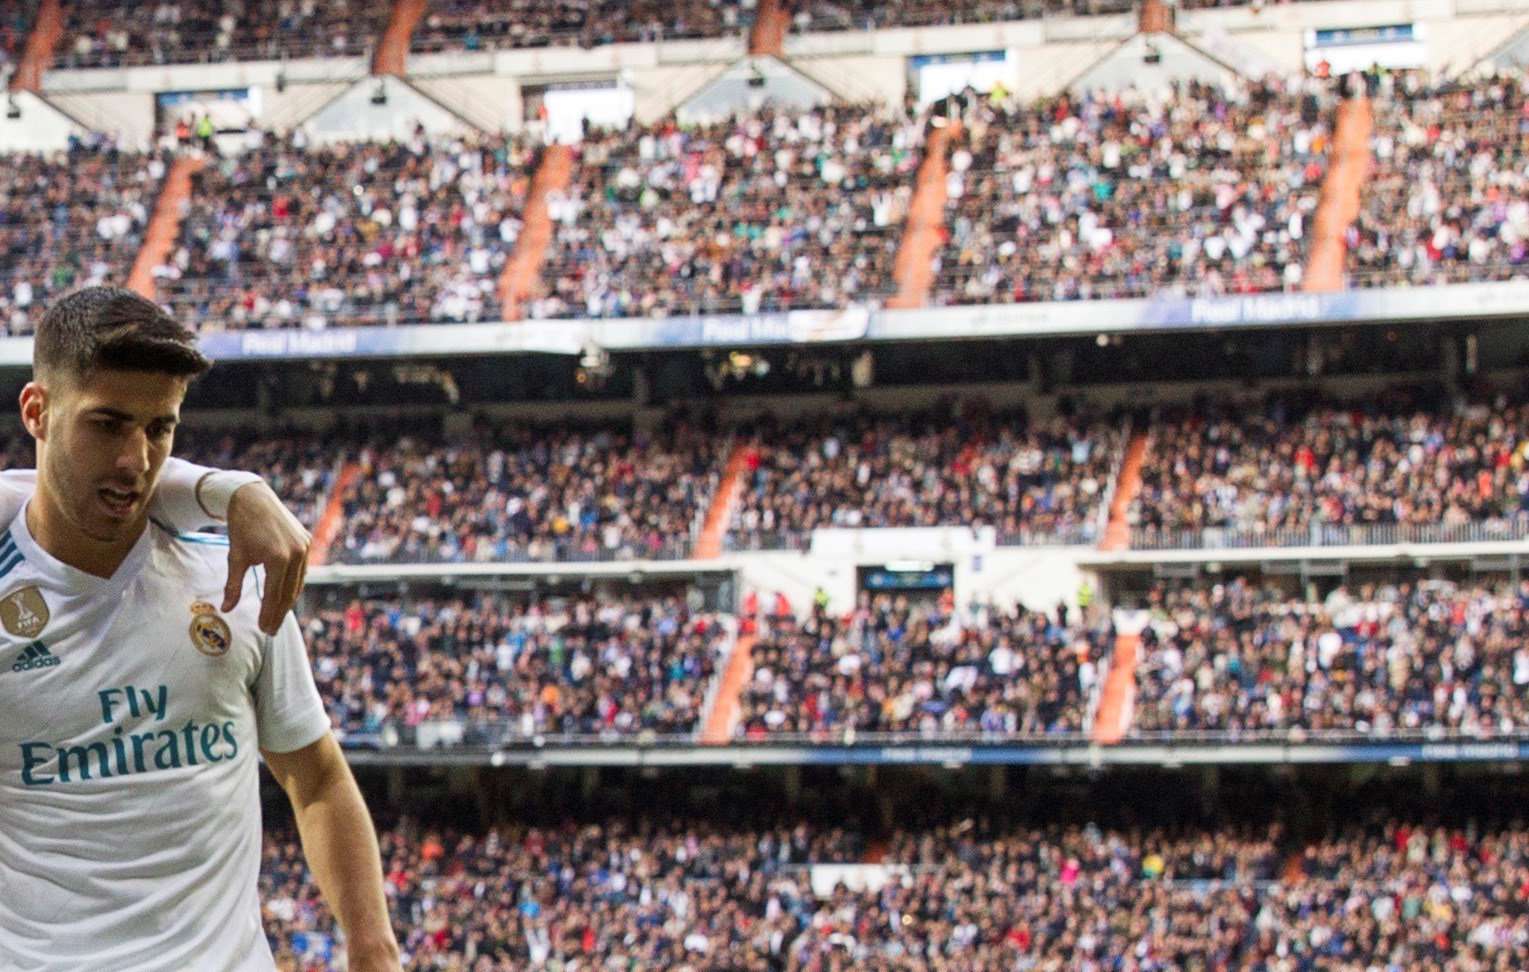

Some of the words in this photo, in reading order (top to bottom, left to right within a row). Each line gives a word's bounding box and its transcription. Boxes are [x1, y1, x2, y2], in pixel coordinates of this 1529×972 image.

[12, 653, 61, 673] adidas
[98, 685, 168, 723] Fly
[19, 718, 239, 785] Emirates
